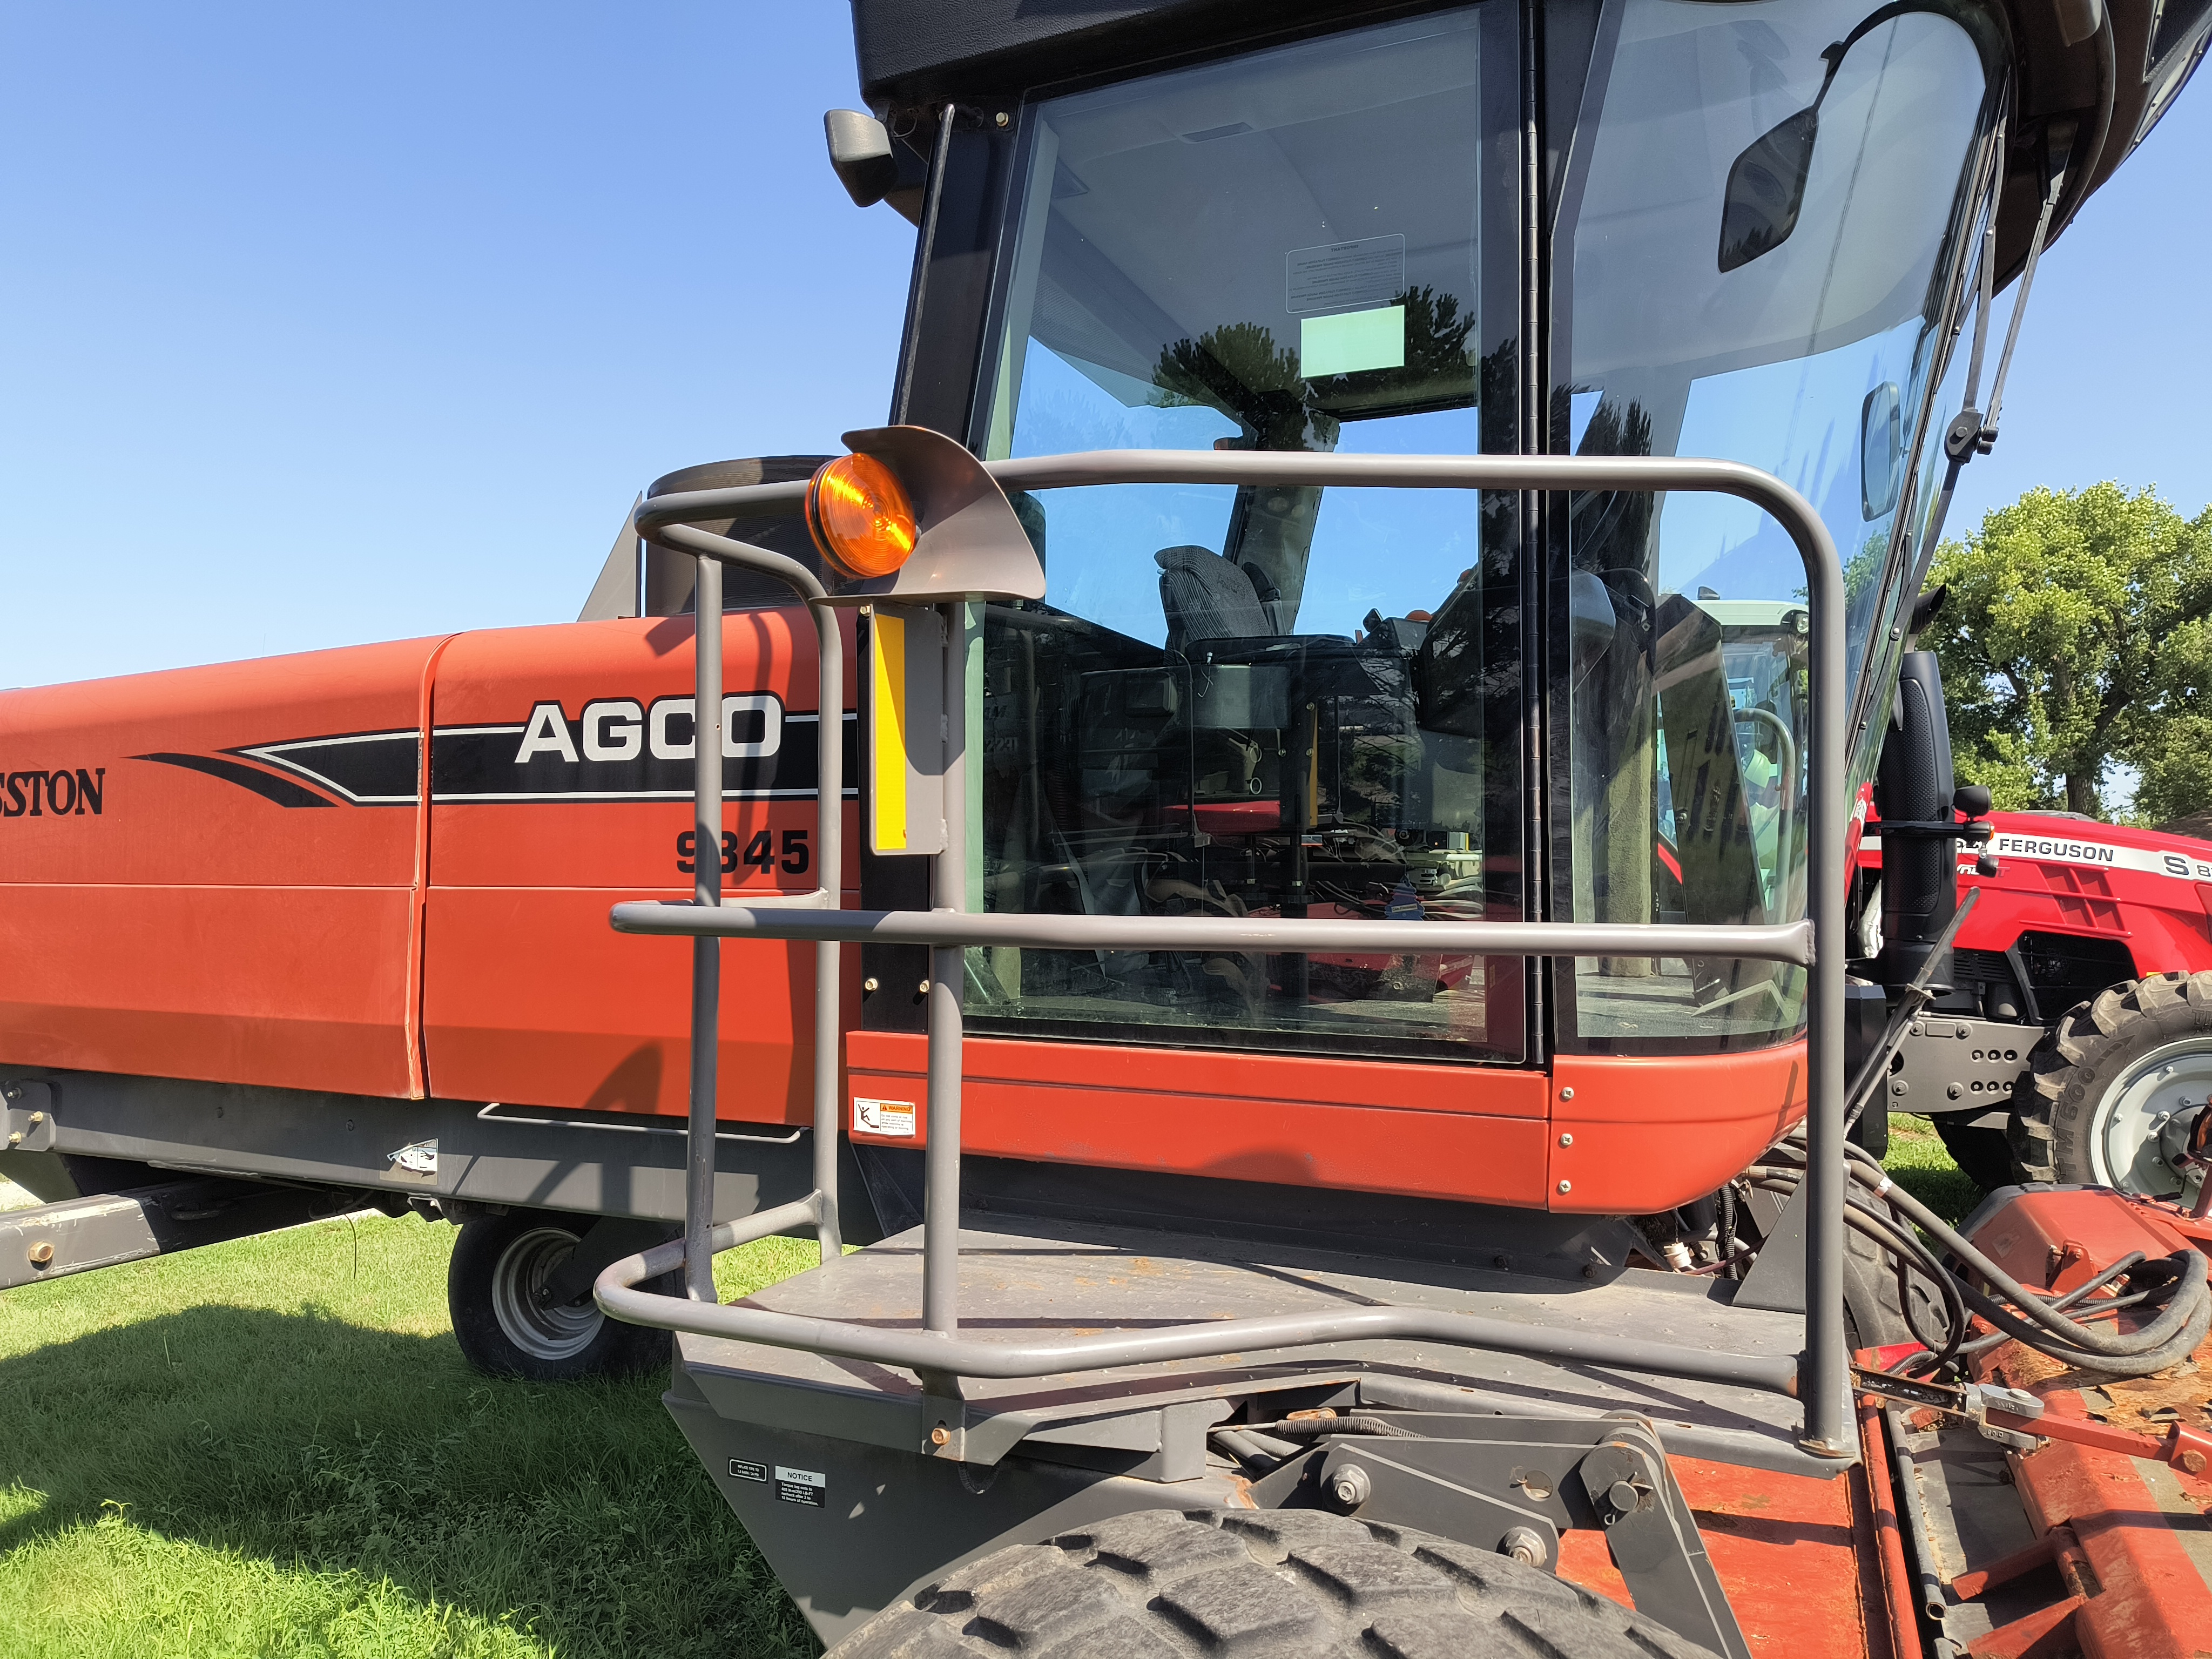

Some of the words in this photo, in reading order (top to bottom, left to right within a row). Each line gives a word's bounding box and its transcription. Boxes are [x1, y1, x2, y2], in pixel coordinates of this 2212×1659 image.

[515, 694, 781, 763] AGCO
[0, 767, 106, 817] STON
[1999, 838, 2114, 861] FERGUSON
[2163, 855, 2189, 875] S
[787, 1472, 813, 1482] NOTICE
